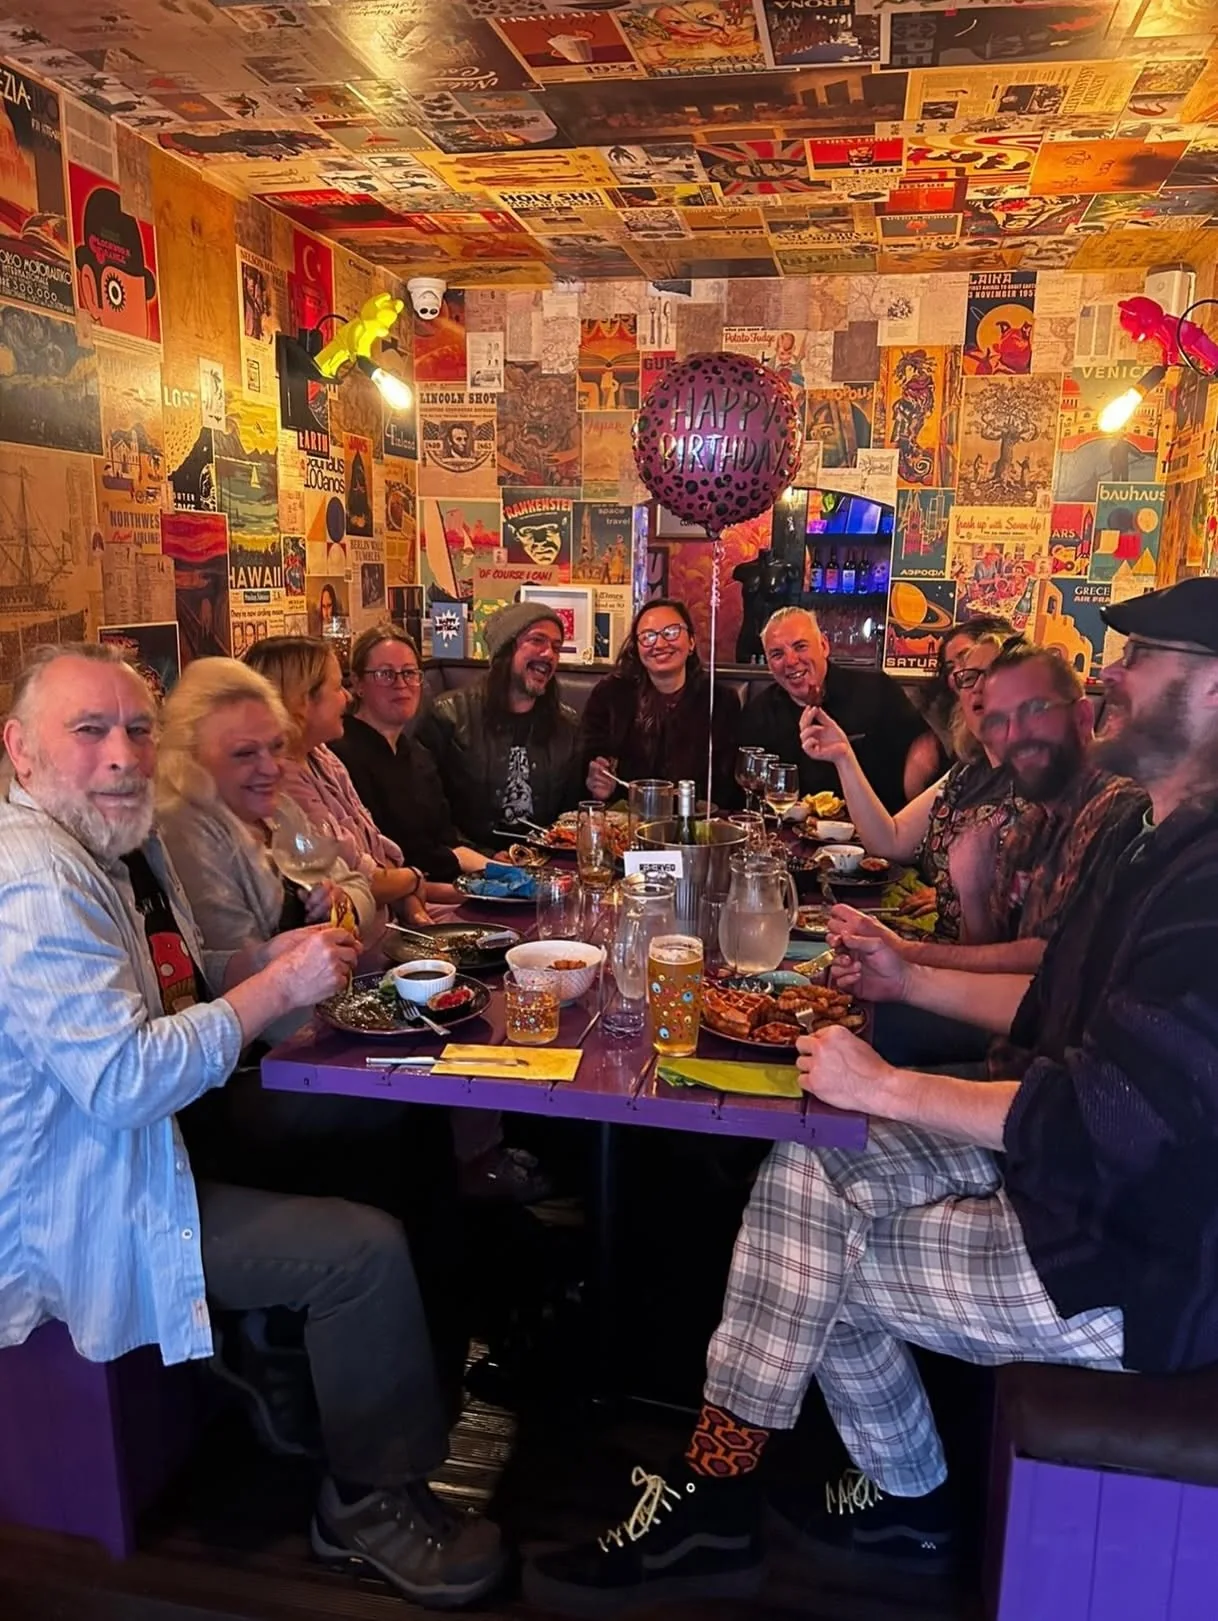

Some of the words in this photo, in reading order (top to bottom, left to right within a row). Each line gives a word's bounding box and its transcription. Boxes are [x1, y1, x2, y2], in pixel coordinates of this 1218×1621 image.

[969, 273, 1012, 284] LAIKA
[975, 289, 1017, 298] NOVEMBER
[420, 392, 465, 404] LINCOLN
[468, 392, 496, 404] SHOT
[670, 387, 778, 433] HAPPY
[299, 429, 329, 453] EARTH
[660, 432, 787, 476] BIRTHDAY
[606, 517, 630, 525] travel
[229, 566, 281, 588] HAWAII
[492, 568, 525, 580] COURSE
[886, 657, 938, 668] SATUR
